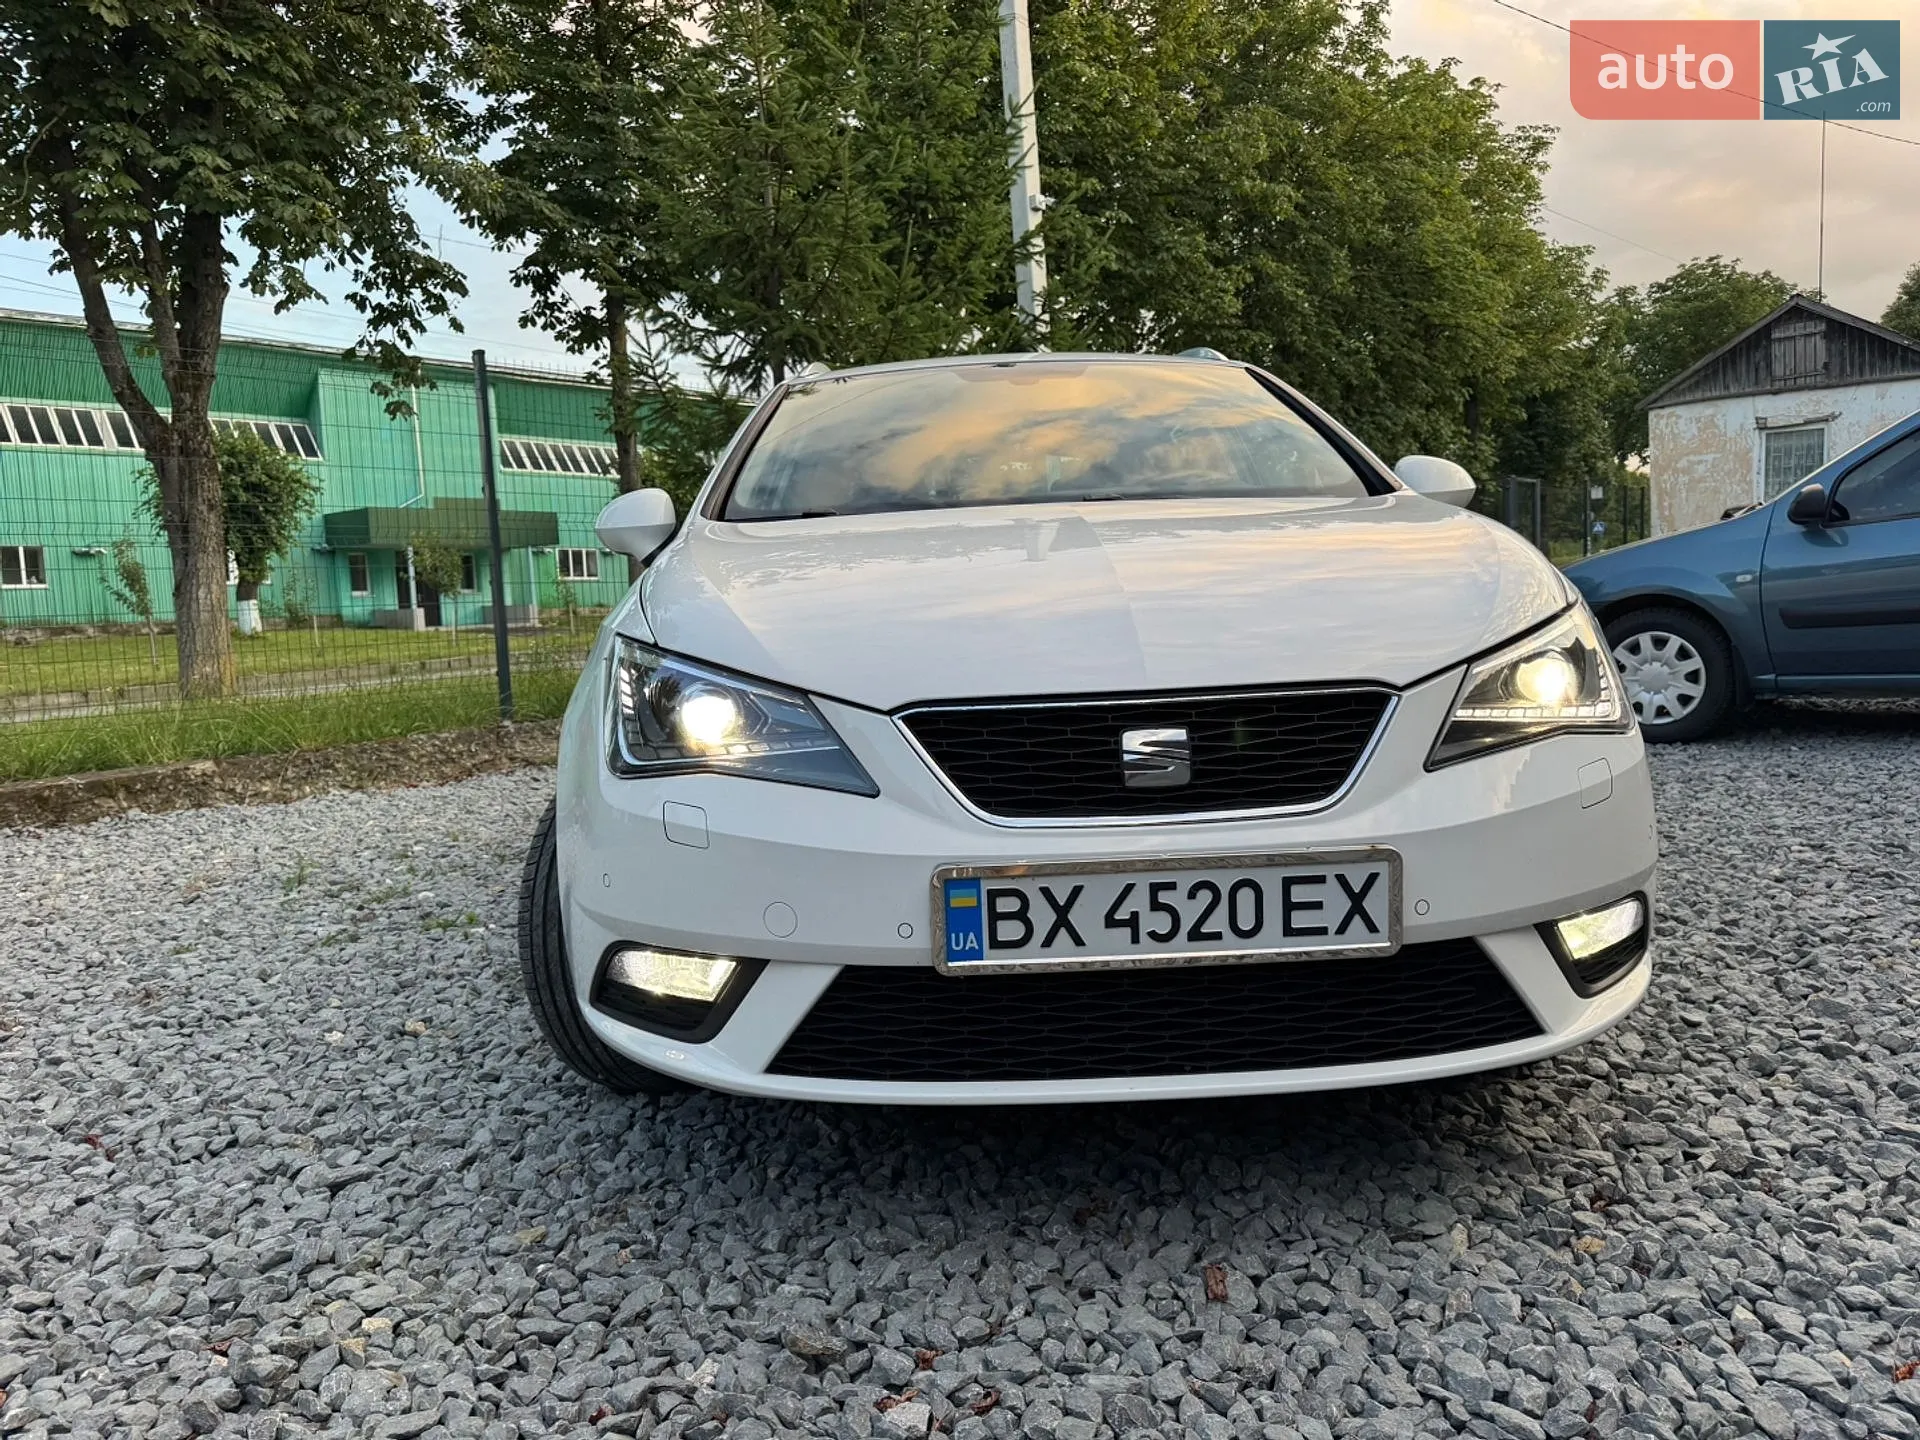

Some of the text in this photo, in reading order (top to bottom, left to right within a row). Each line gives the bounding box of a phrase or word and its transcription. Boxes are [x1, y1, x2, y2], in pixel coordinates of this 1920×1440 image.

[986, 871, 1381, 951] BX 4520 EX
[951, 932, 979, 951] UA
